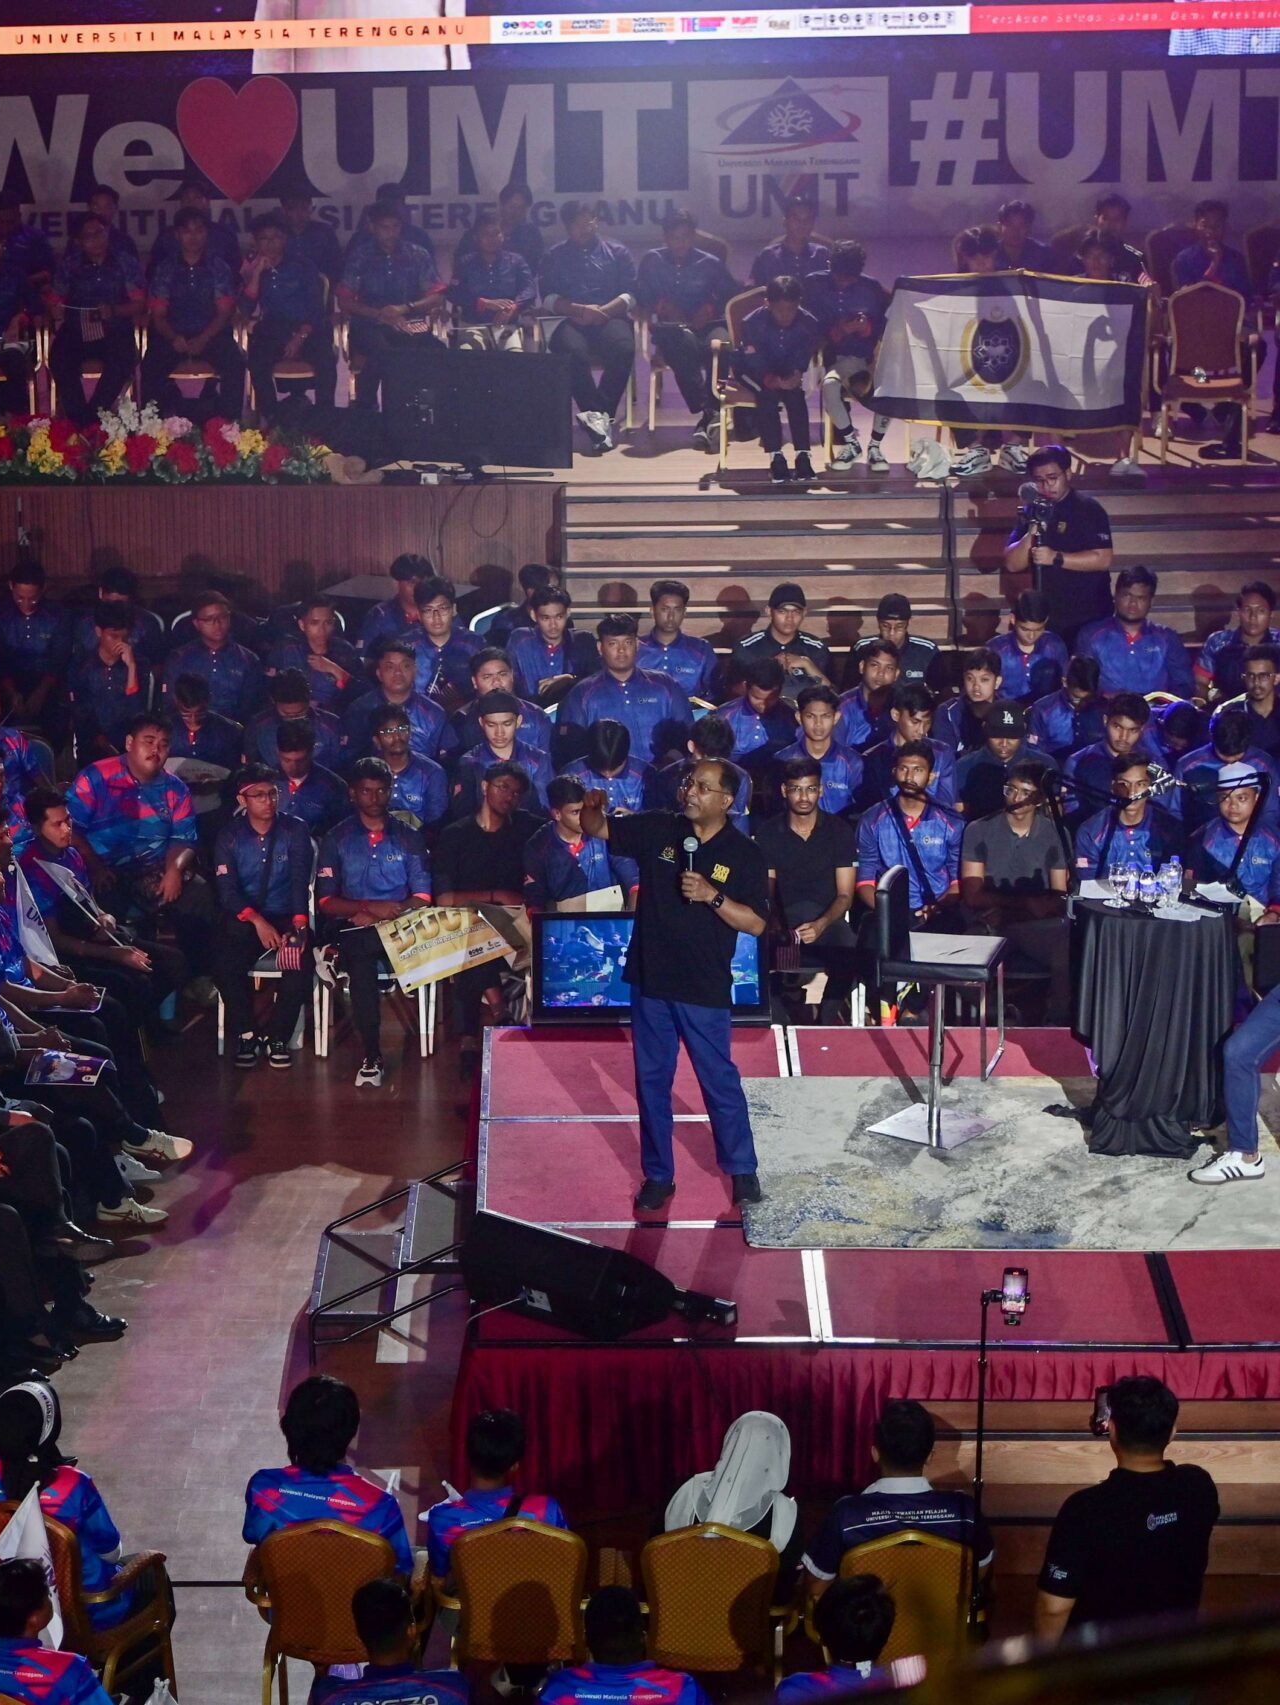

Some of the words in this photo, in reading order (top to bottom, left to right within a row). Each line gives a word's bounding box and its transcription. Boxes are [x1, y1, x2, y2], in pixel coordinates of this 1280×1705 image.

[15, 31, 155, 44] UNIVERSITI
[173, 28, 290, 41] MALAYSIA
[309, 25, 465, 38] TERENGGANU
[300, 80, 673, 198] UMT
[718, 172, 860, 218] UMT
